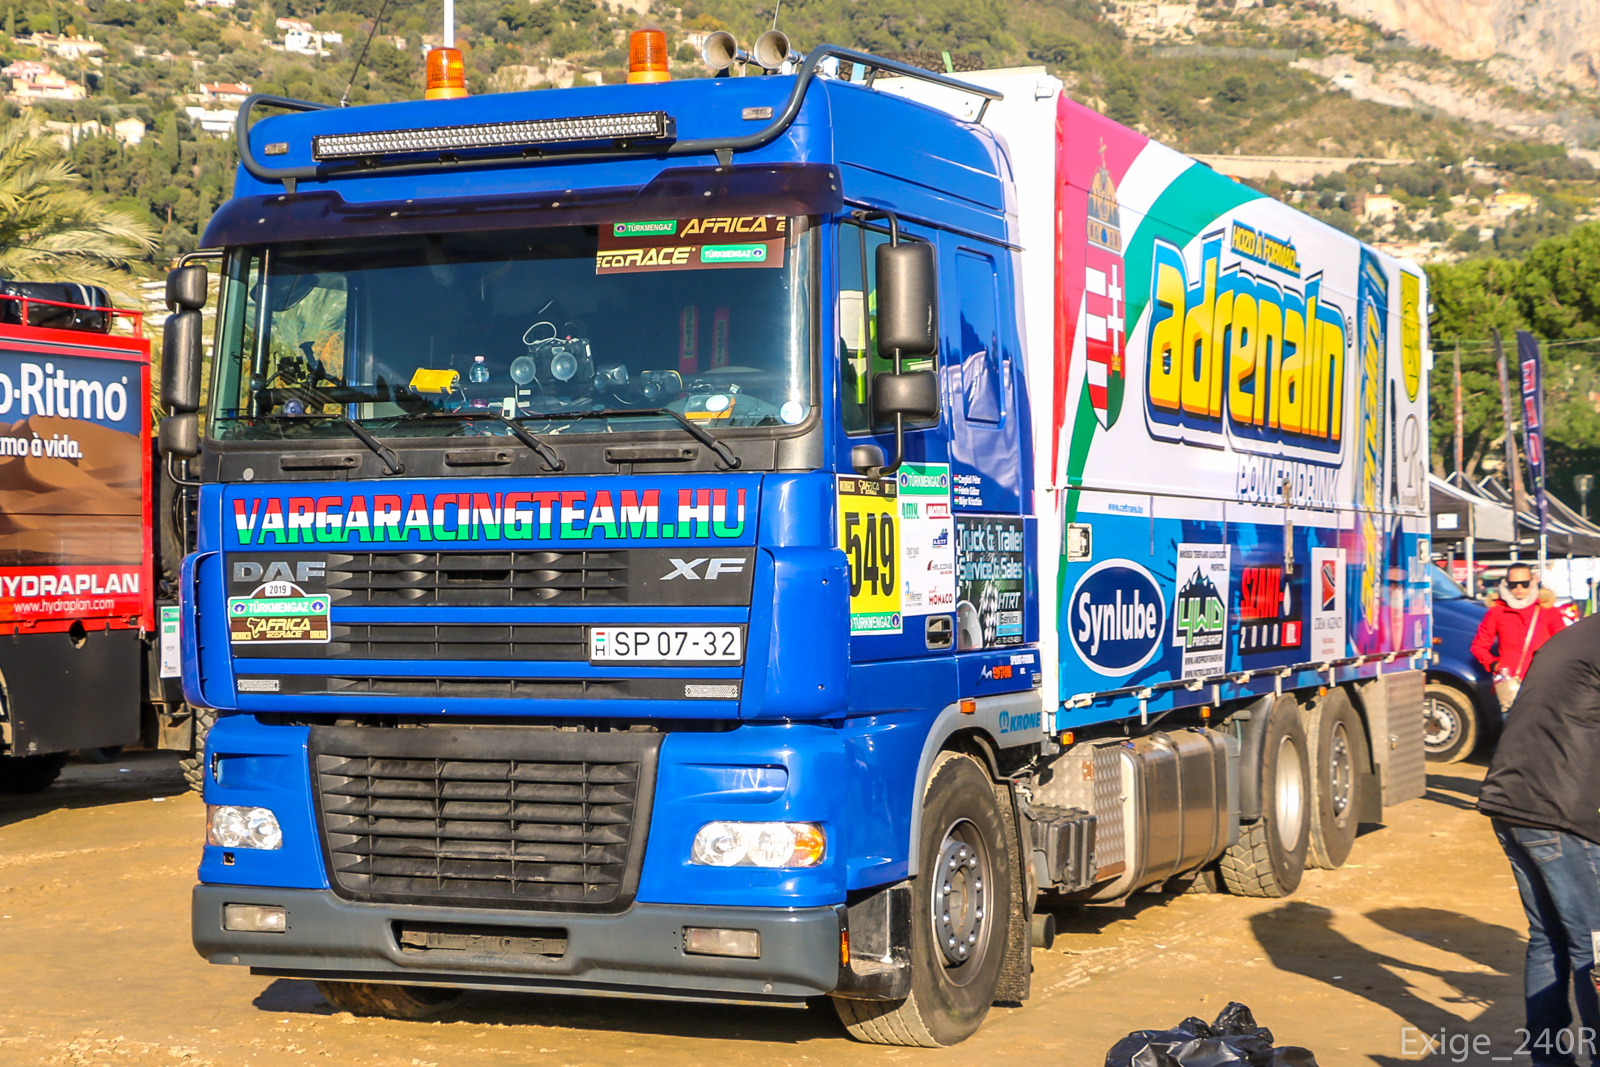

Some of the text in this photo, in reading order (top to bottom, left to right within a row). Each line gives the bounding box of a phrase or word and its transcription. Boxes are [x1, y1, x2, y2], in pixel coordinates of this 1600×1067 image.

[627, 223, 673, 233] TÜRKMENGAZ
[679, 216, 768, 238] AFRICA
[1231, 225, 1256, 255] HOZD
[1255, 235, 1262, 259] A
[704, 250, 752, 259] TÜRKMENGAZ
[1148, 256, 1344, 441] adrenalin
[31, 431, 42, 458] à
[44, 433, 83, 459] vida.
[908, 472, 940, 488] TÜRKMENGAZ
[1237, 456, 1339, 514] POWER DRINK
[233, 488, 747, 545] VARGARACINGTEAM.HU
[957, 522, 1023, 552] Truck & Trailer
[844, 511, 895, 598] 549
[233, 561, 326, 582] DAF
[659, 558, 747, 580] XF
[959, 555, 1023, 580] Service & Sales
[0, 573, 140, 598] YDRAPLAN
[269, 585, 287, 595] 2019
[14, 598, 115, 615] www.hydraplan.com
[248, 601, 309, 614] TÜRKMENGAZ
[928, 593, 953, 606] MONACO
[997, 592, 1021, 609] HTRT
[254, 617, 311, 636] AFRICA
[852, 614, 891, 630] TÜRKMENGAZ
[1078, 589, 1157, 657] Synlube
[1177, 597, 1224, 648] 4WD
[595, 631, 736, 656] H SP 07-32
[1010, 711, 1041, 732] KRONE
